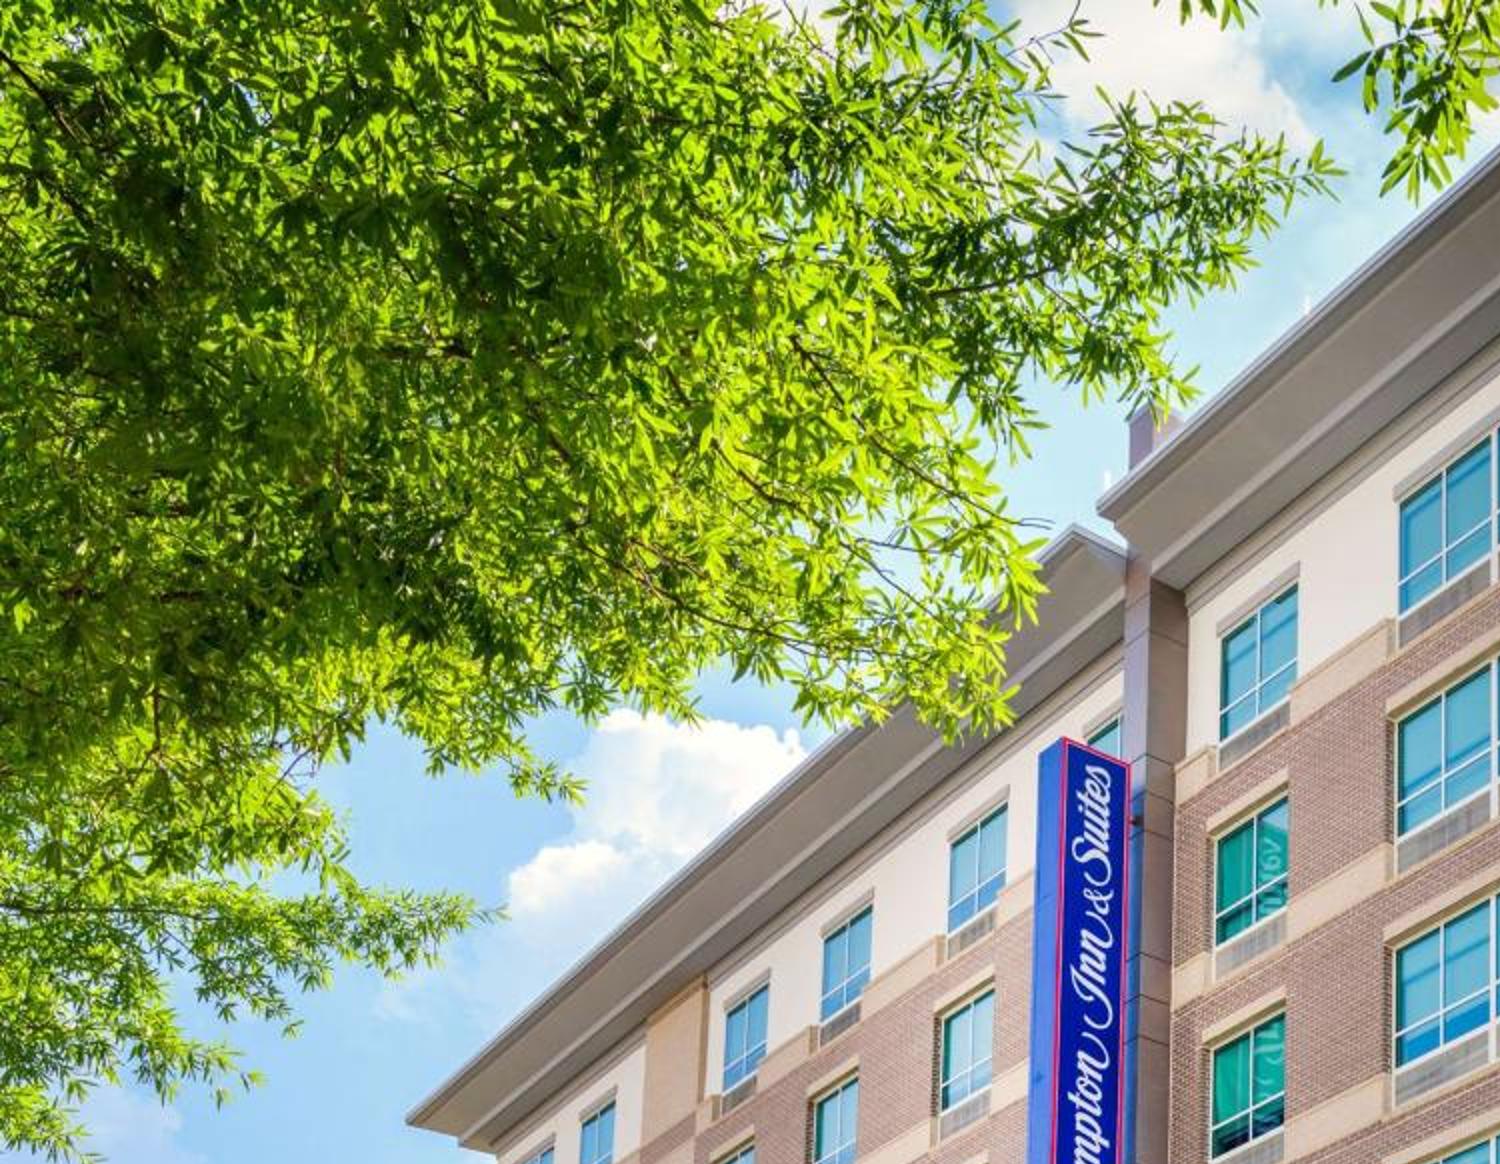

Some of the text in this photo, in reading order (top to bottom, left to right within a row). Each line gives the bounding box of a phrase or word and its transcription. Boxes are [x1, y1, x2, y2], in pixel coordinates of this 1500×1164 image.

[1072, 764, 1112, 886] Suites
[1083, 888, 1114, 915] &
[1070, 911, 1114, 1030] Inn
